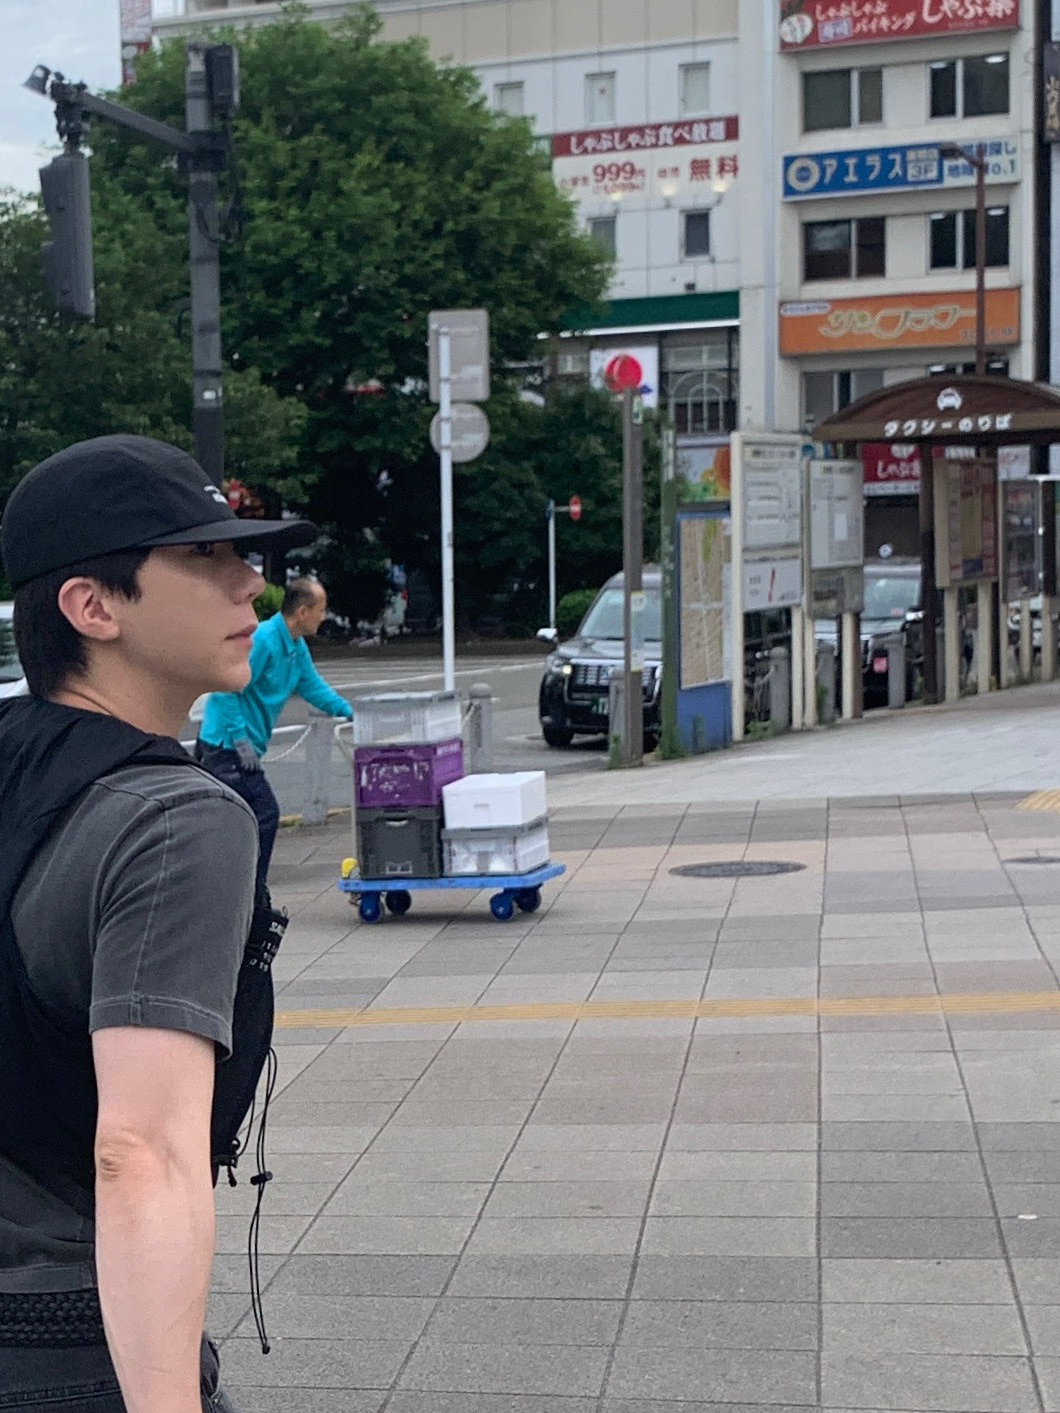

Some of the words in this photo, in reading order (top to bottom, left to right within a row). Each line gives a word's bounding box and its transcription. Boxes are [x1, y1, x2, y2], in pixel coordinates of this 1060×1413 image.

[570, 119, 726, 155] しゃぶしゃぶ食べ放題
[690, 154, 738, 181] 無料
[823, 153, 903, 185] アエラス
[884, 413, 1013, 437] タクシーのりば
